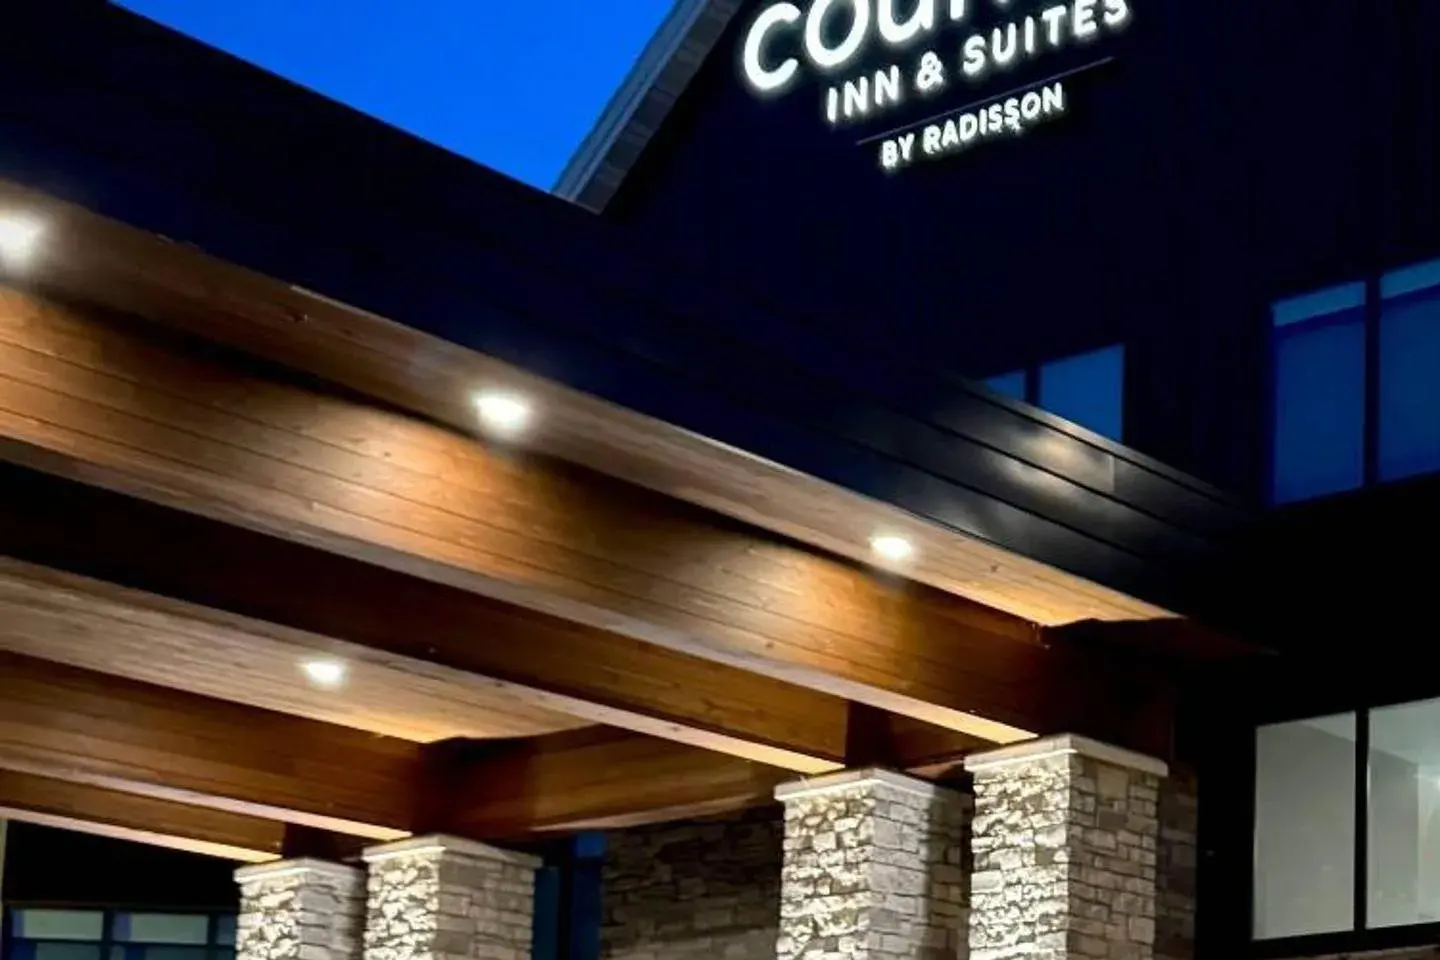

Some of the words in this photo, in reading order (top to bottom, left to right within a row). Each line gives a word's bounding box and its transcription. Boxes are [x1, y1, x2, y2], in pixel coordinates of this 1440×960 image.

[826, 64, 901, 124] INN
[914, 50, 945, 93] &
[962, 0, 1129, 77] SUITES
[880, 132, 915, 170] BY
[922, 82, 1065, 155] RADISSON
